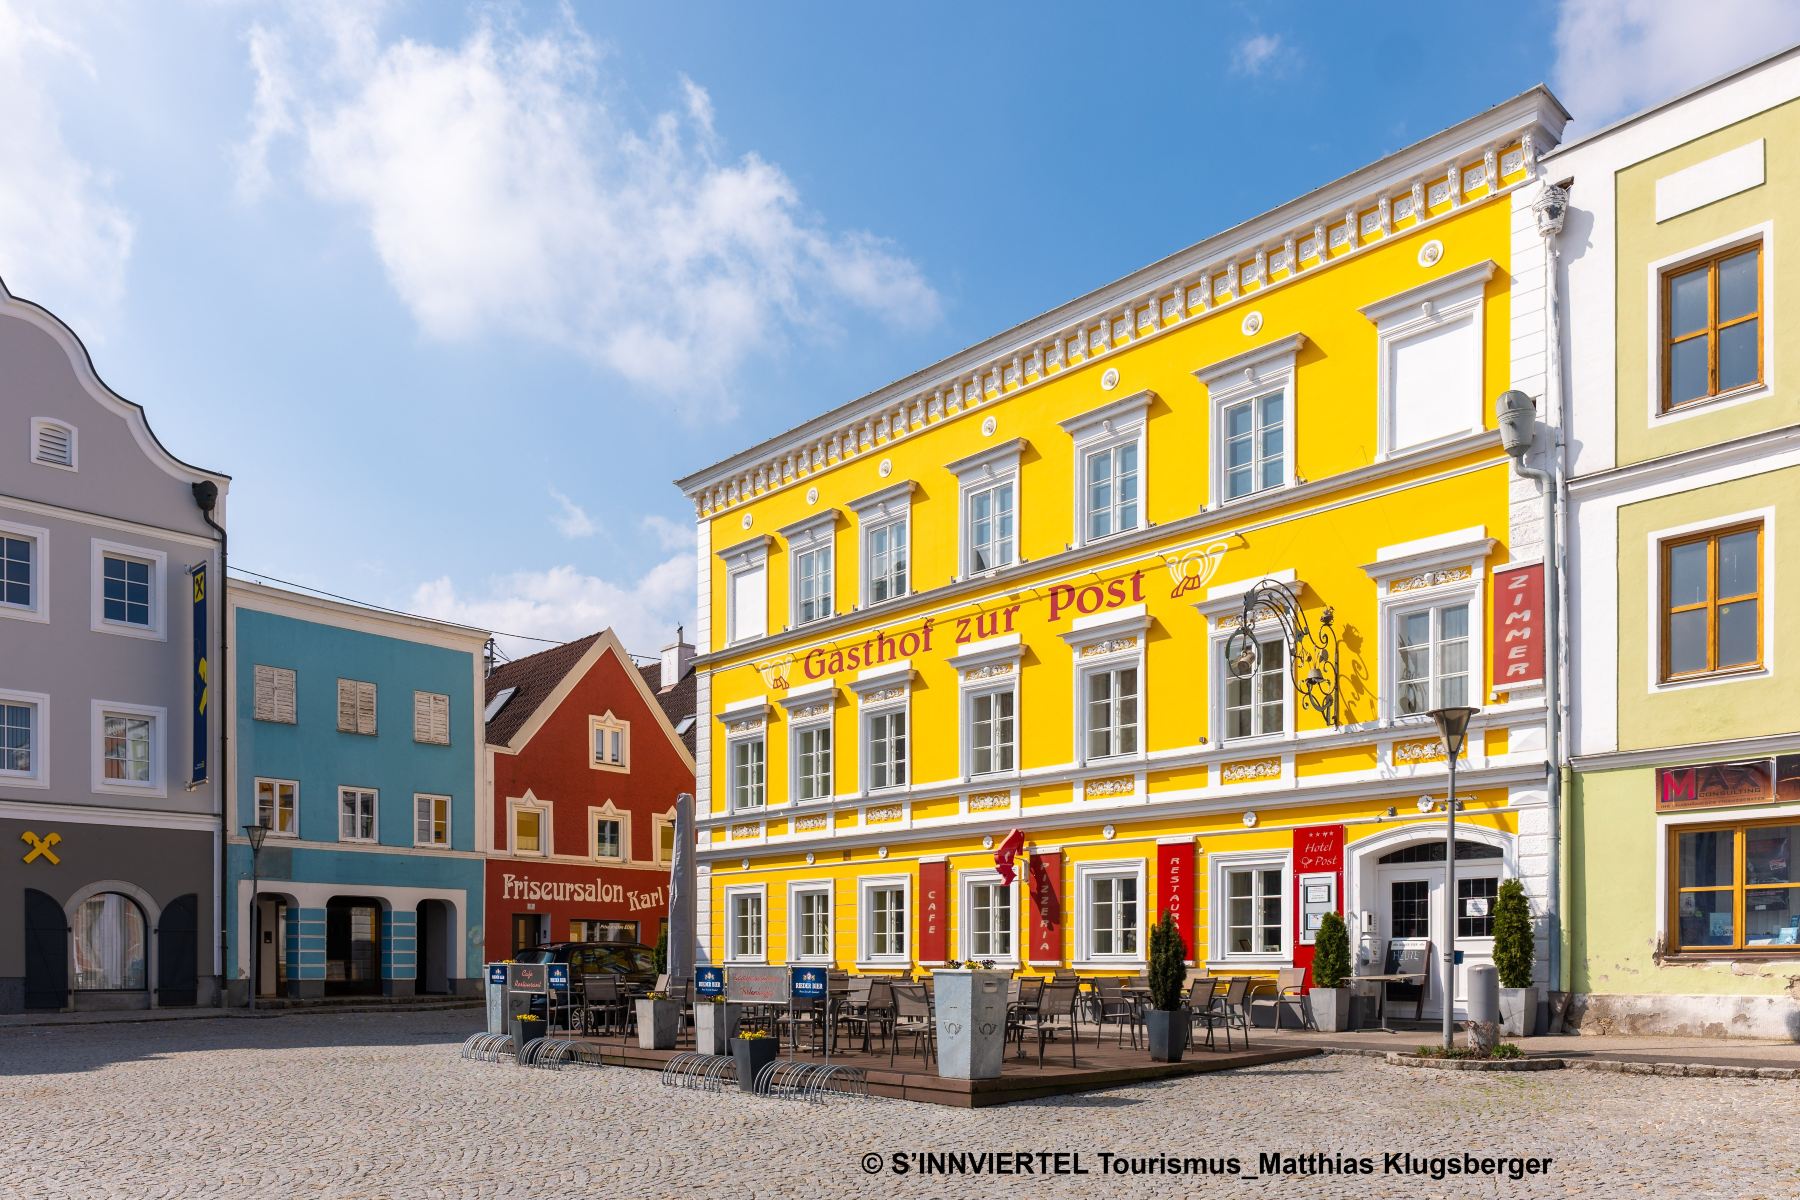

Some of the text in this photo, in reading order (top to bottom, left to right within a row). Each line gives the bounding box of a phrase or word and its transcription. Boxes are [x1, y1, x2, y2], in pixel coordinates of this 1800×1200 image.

[803, 569, 1147, 680] Gasthof zur Post
[1505, 574, 1531, 677] ZIMMER
[1305, 839, 1334, 853] Hotel
[1314, 855, 1338, 866] Post
[502, 873, 665, 912] Friseursalon Karl
[927, 891, 937, 934] CAFE
[1040, 862, 1049, 950] PIZZERIA
[1170, 857, 1180, 931] RESTAURA
